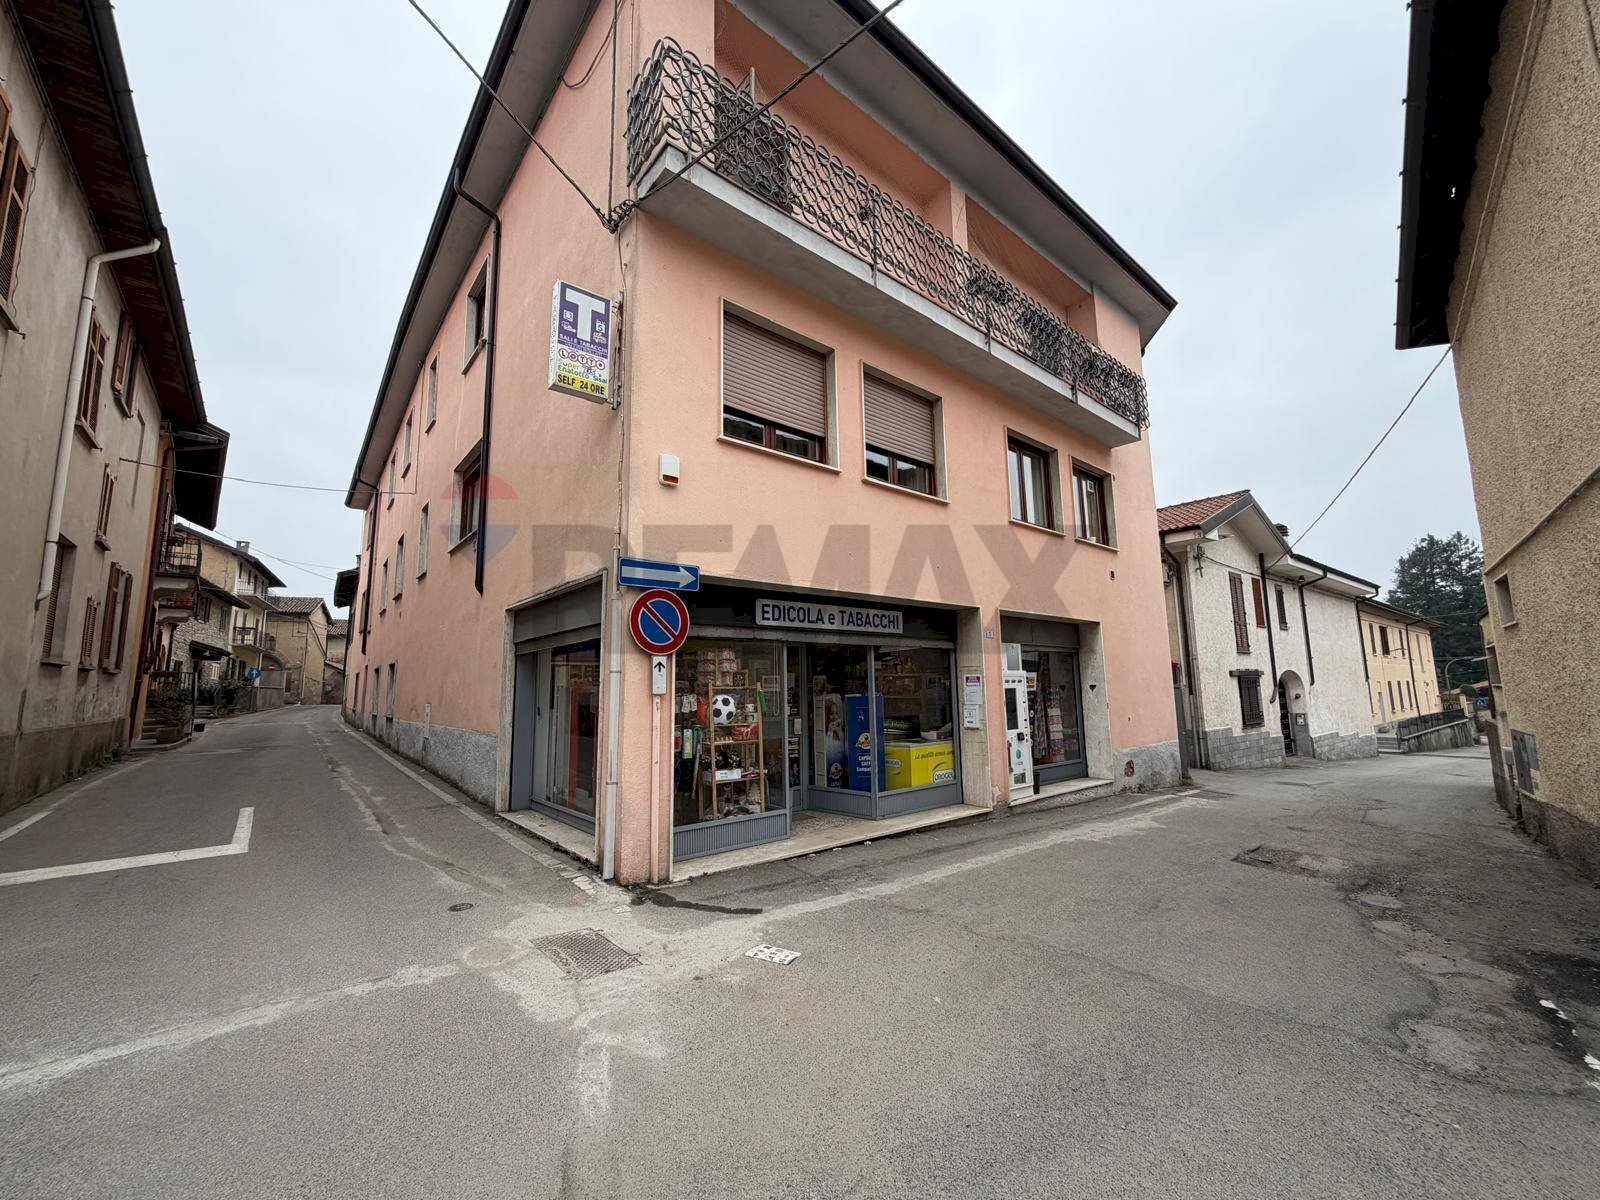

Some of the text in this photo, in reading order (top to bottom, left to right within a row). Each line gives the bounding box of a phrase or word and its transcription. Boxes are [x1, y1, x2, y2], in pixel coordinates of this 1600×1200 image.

[557, 373, 605, 395] SELF 24 ORE
[761, 603, 900, 630] EDICOLA e TABACCHI
